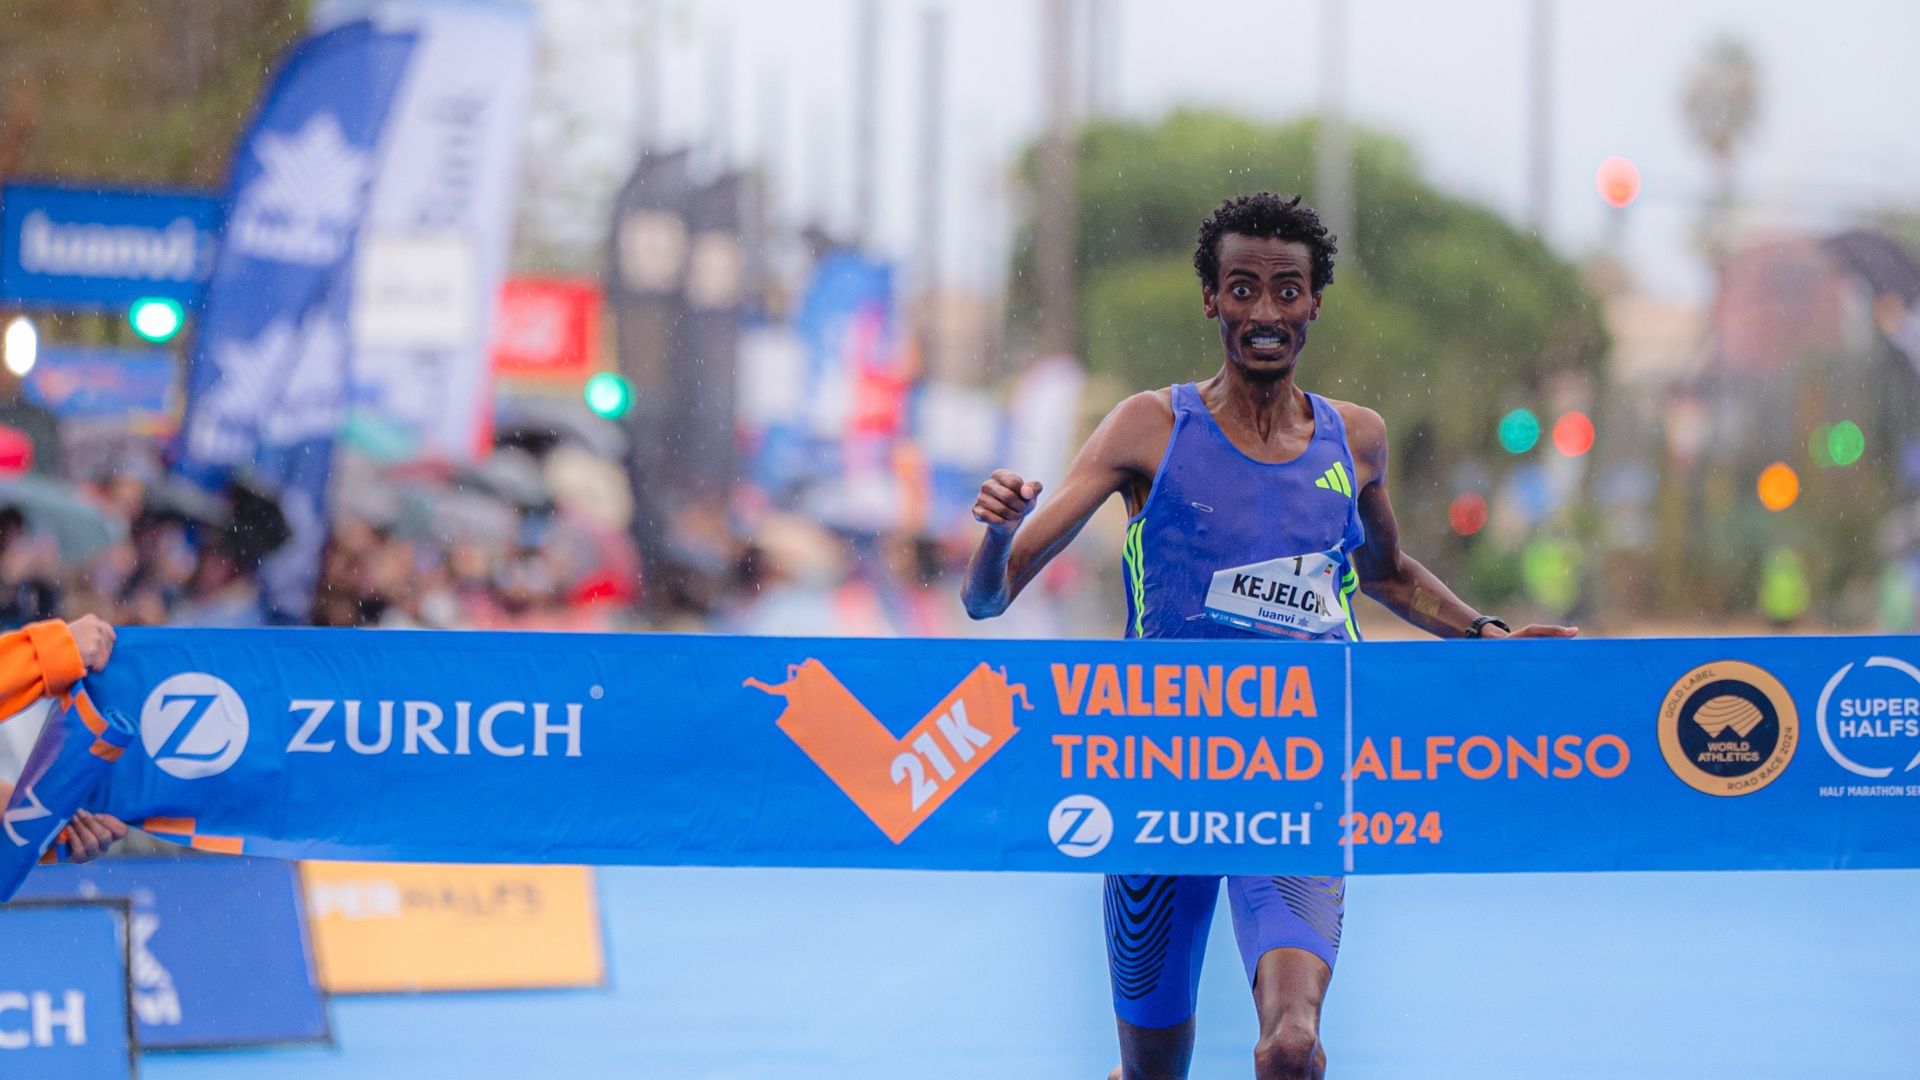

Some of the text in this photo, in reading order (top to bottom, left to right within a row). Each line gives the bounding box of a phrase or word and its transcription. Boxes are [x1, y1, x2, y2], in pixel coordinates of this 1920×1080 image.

[1293, 556, 1303, 576] 1
[1258, 607, 1296, 624] luanvi
[1050, 663, 1317, 717] VALENCIA
[1665, 669, 1716, 718] GOLD LABEL
[1840, 698, 1919, 717] SUPER
[286, 699, 584, 757] ZURICH
[1840, 719, 1919, 738] HALFS
[890, 698, 992, 812] 21K
[1051, 734, 1630, 780] TRINIDAD ALFONSO
[1697, 752, 1760, 763] ATHLETICS
[1707, 741, 1750, 752] WORLD
[1726, 726, 1793, 791] ROAD RACE 2024
[1820, 786, 1845, 797] HALF
[1847, 786, 1904, 797] MARATHON
[1134, 810, 1312, 845] ZURICH
[1338, 811, 1442, 845] 2024
